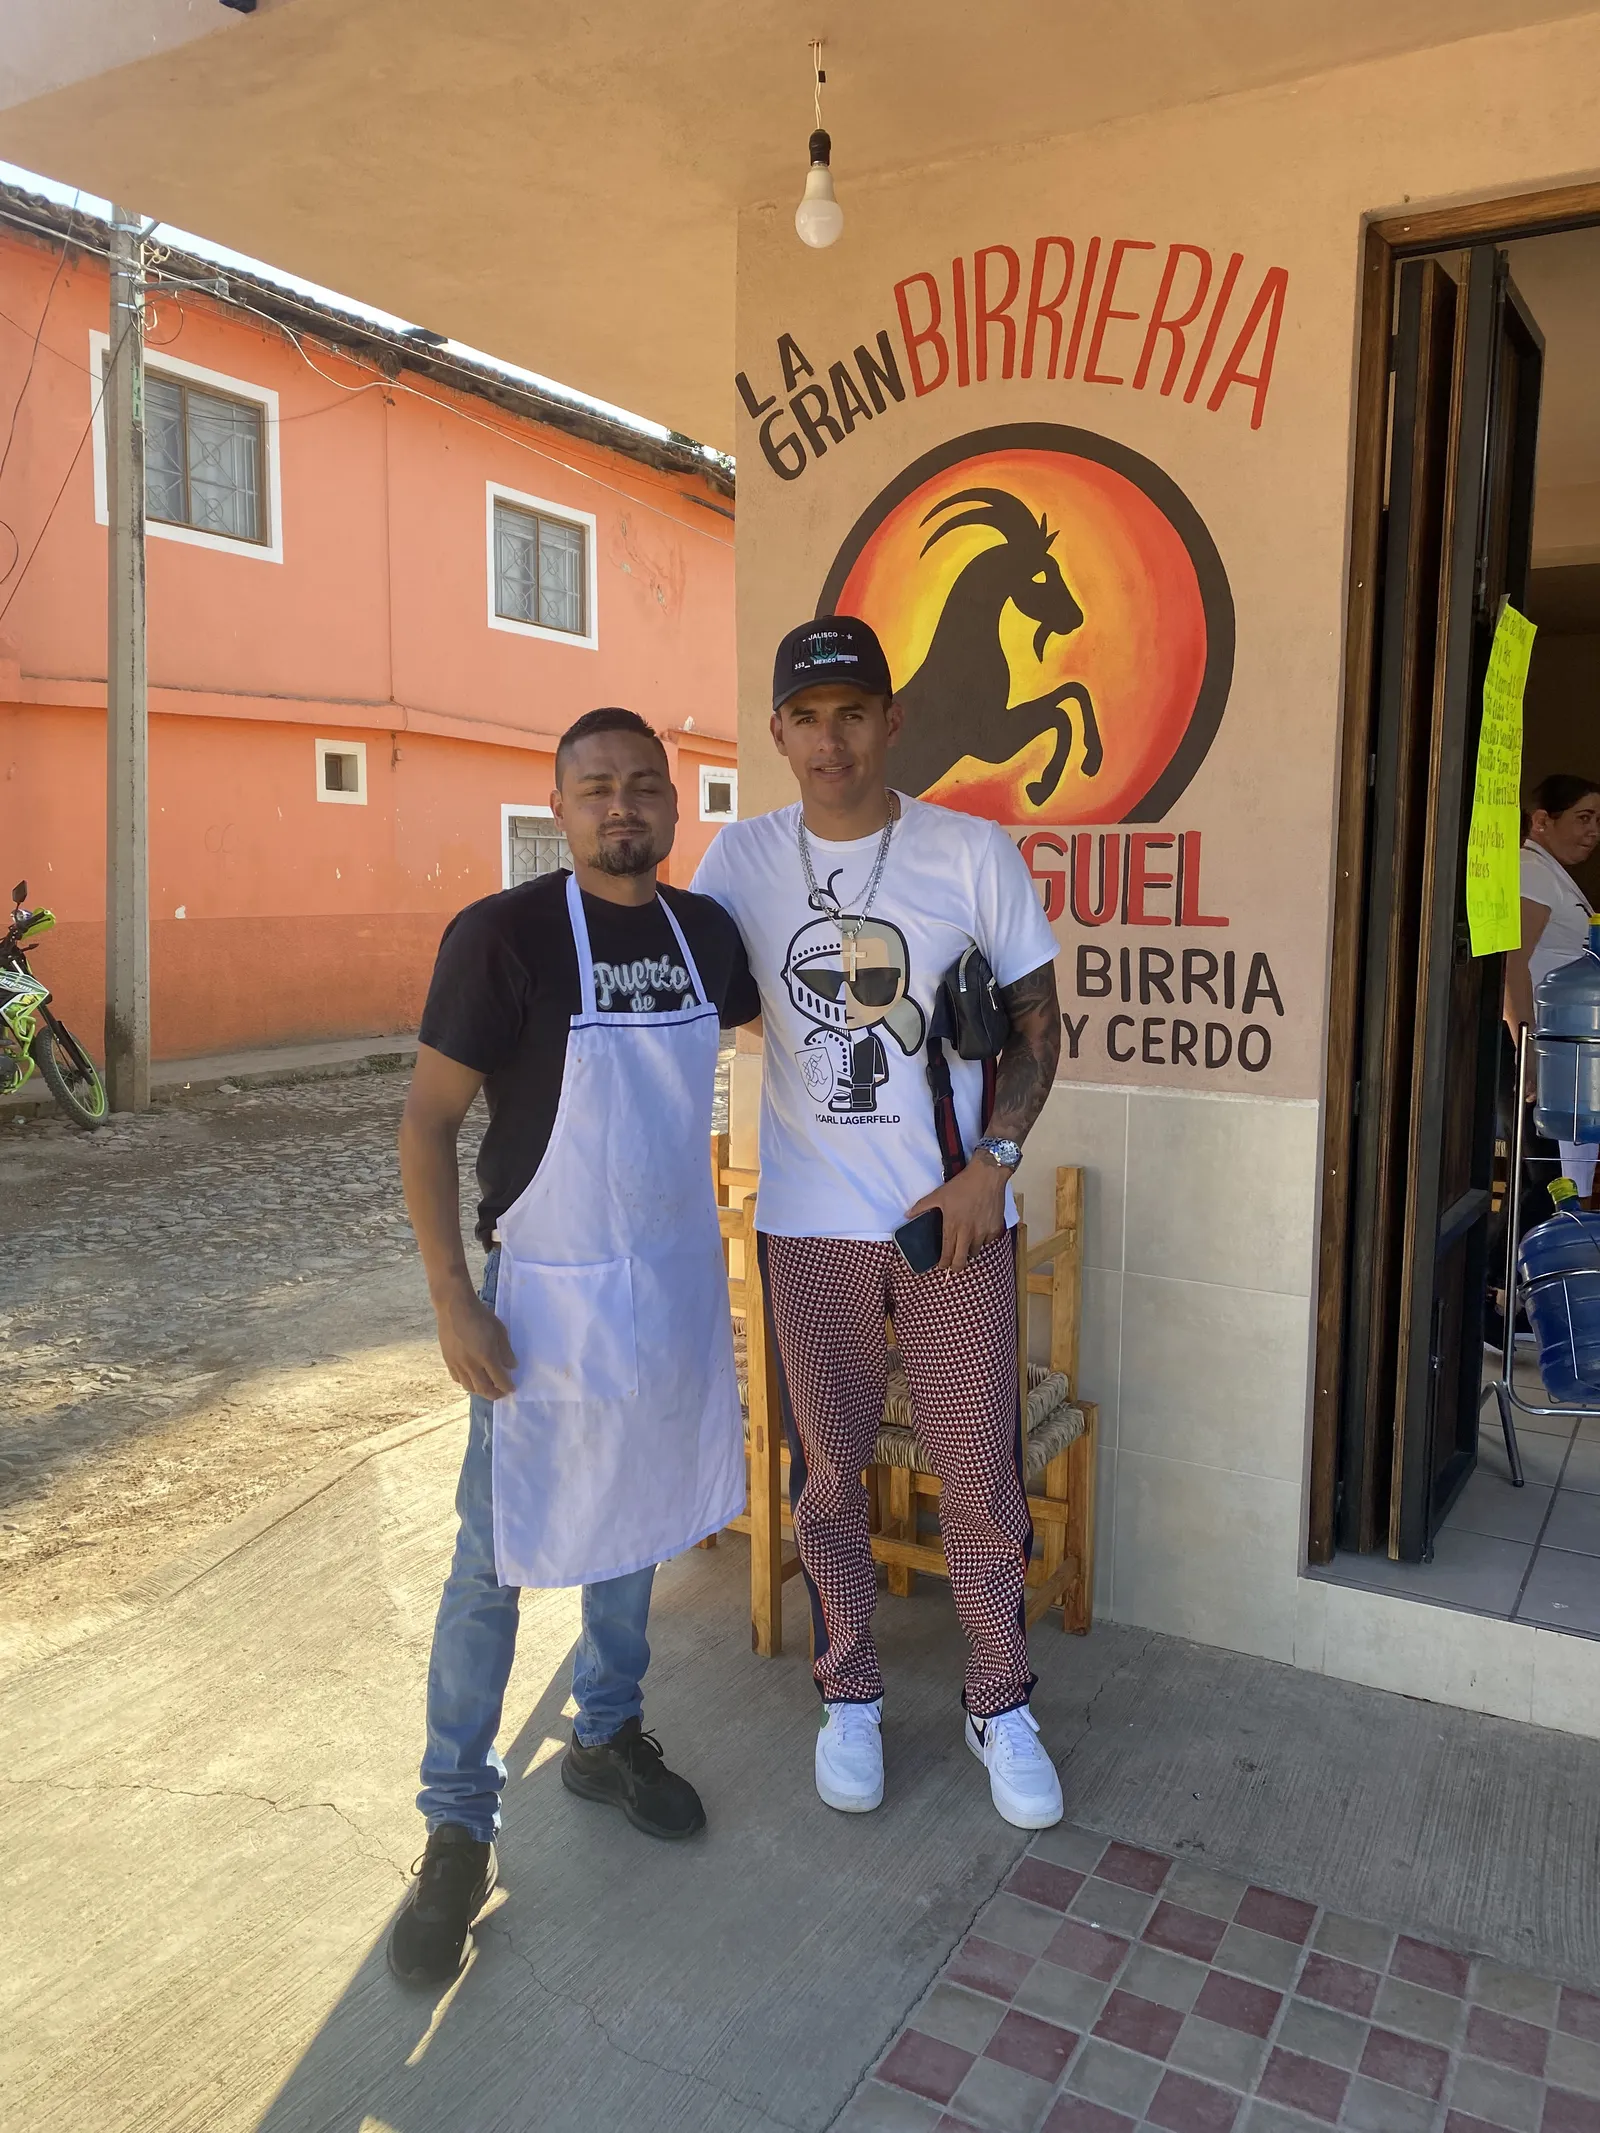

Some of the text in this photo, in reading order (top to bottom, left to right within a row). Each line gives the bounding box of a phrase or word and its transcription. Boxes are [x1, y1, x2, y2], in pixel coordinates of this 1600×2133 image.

[735, 333, 815, 419] LA
[759, 236, 1289, 481] GRAN BIRRIERIA
[808, 631, 838, 641] JALISCO
[1010, 831, 1229, 927] GUEL
[630, 990, 655, 1012] de
[1076, 945, 1284, 1016] BIRRIA
[1062, 1013, 1271, 1072] Y CERDO
[815, 1114, 900, 1125] KARL LAGERFELD
